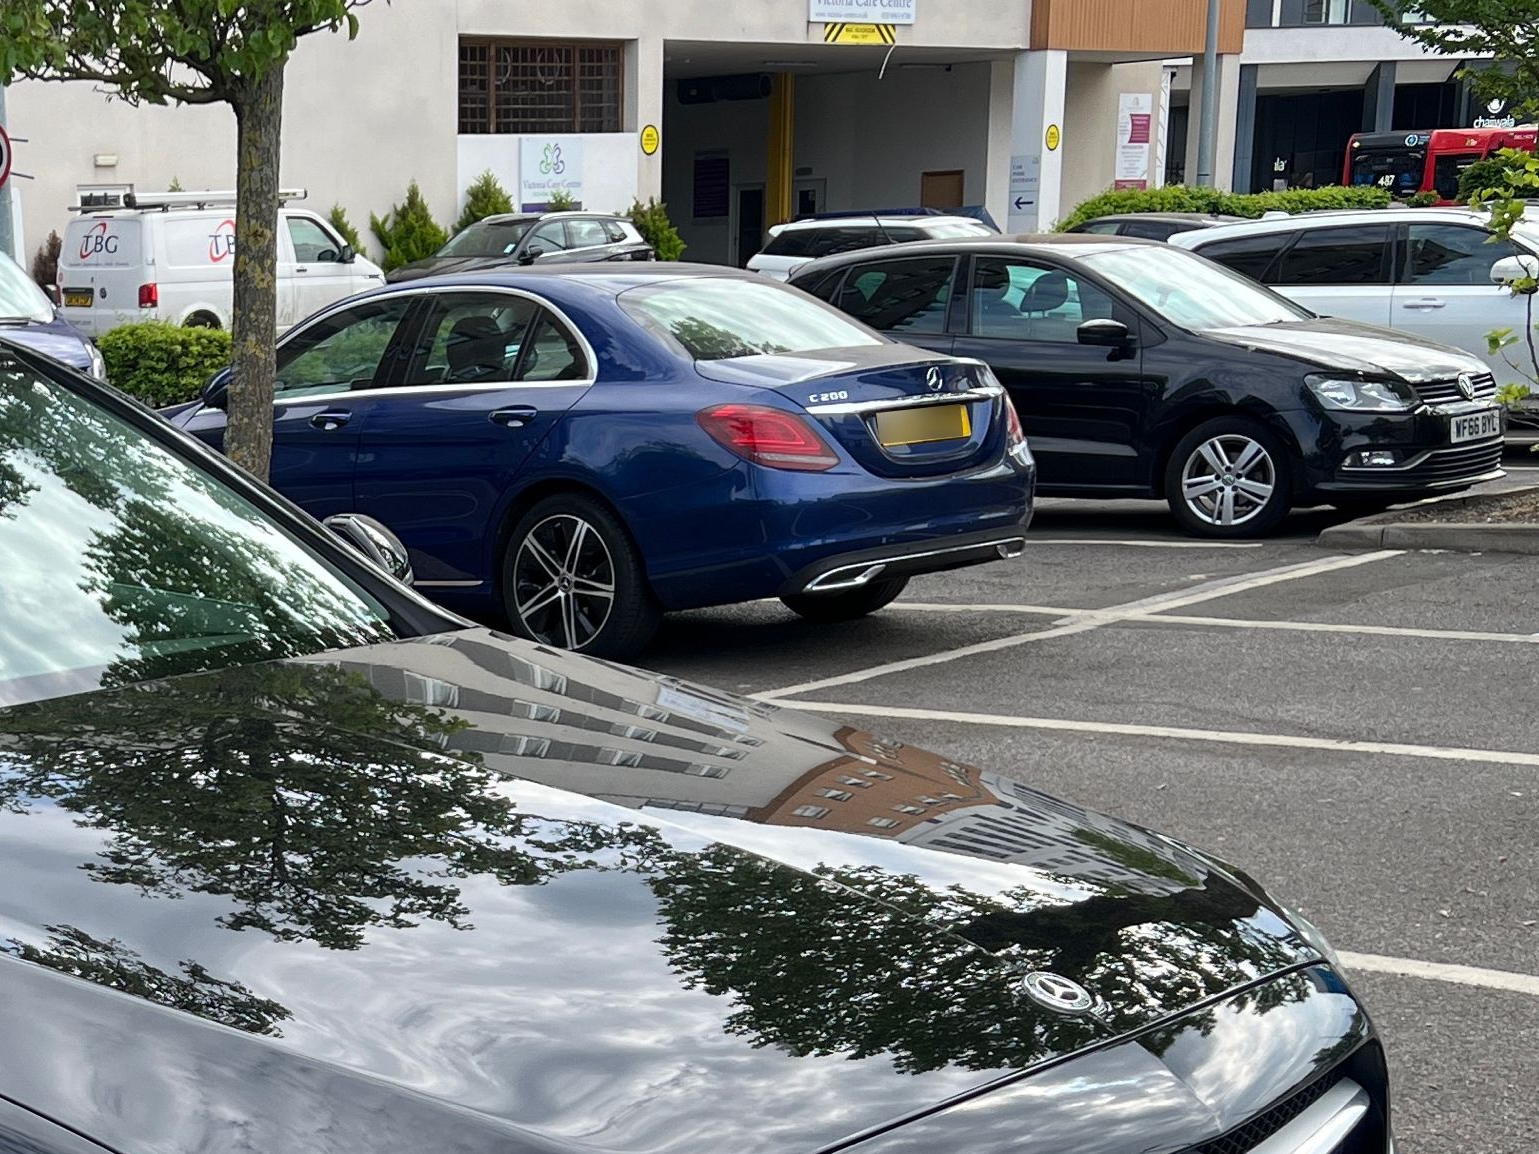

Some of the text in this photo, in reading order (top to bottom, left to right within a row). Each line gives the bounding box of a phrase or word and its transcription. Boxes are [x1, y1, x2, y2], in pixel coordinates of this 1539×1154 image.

[880, 0, 911, 8] Centre
[1377, 173, 1395, 186] 487
[82, 235, 119, 254] TBG
[208, 234, 236, 255] TB
[809, 391, 848, 403] C 200
[1455, 416, 1480, 439] WF66
